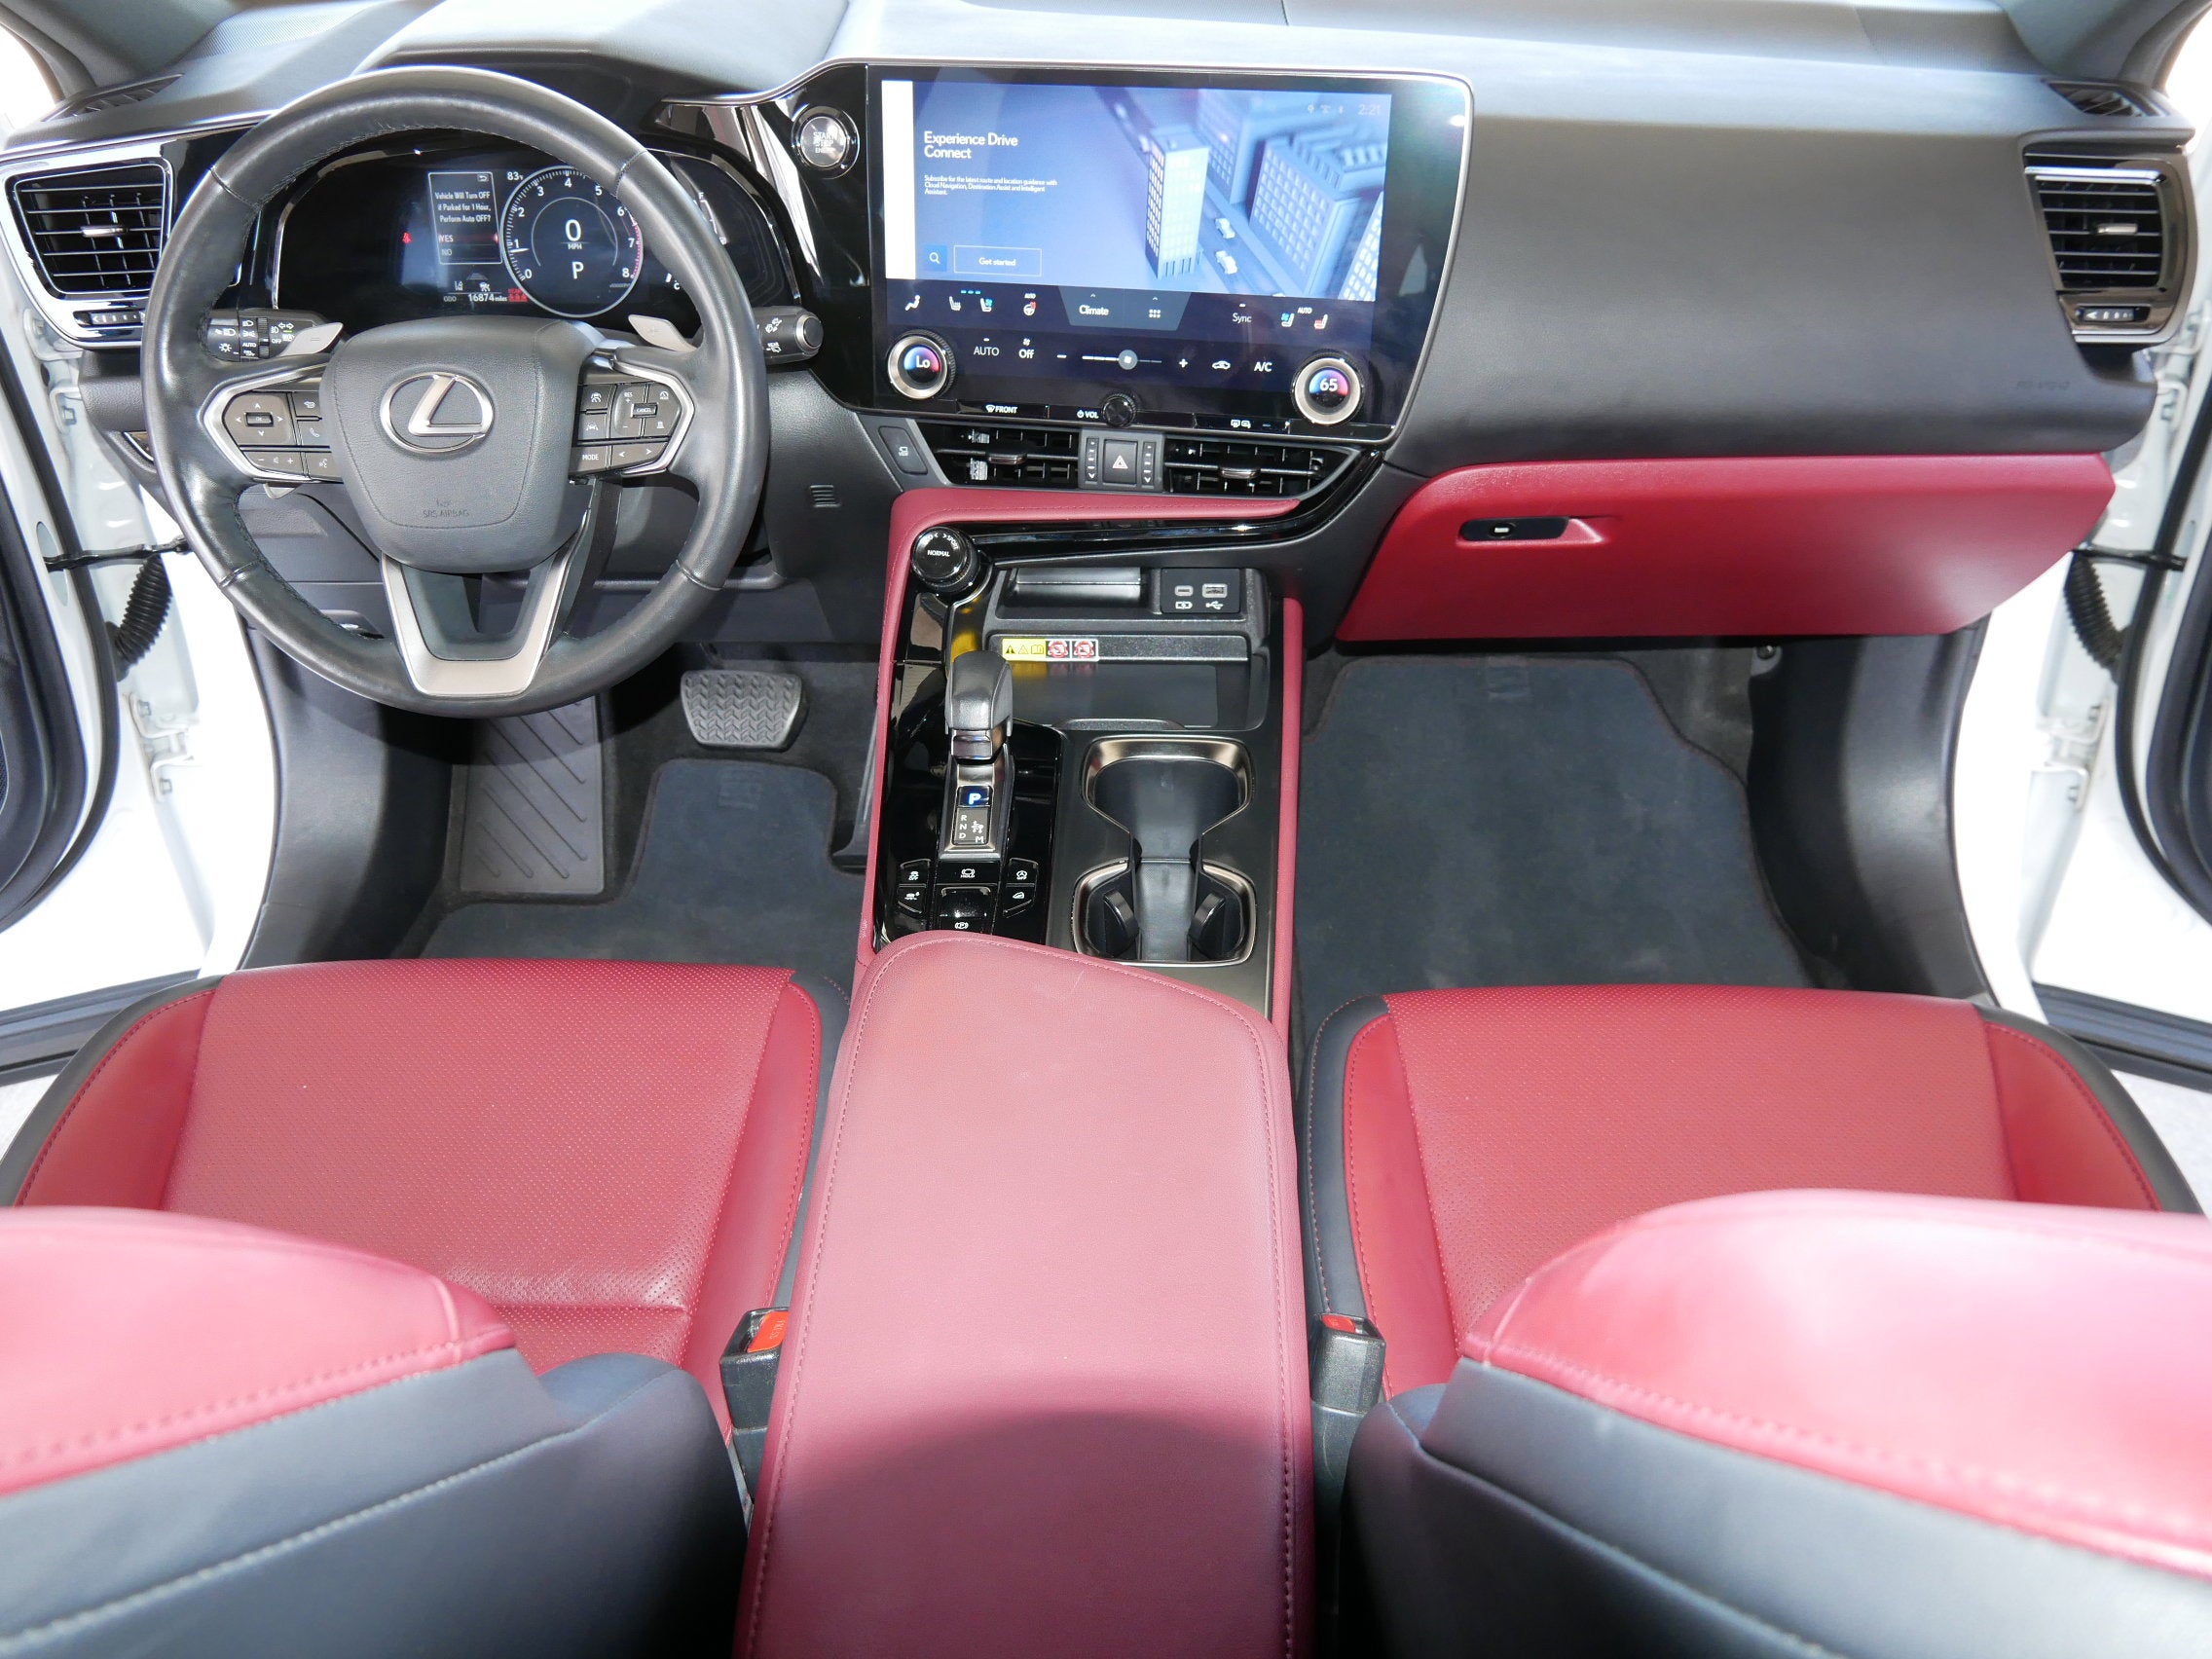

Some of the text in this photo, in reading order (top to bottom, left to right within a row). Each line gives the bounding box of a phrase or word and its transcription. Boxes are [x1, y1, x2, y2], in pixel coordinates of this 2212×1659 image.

[924, 131, 1018, 146] Experience Drive
[924, 146, 972, 160] Connect
[564, 177, 572, 188] 4
[434, 191, 491, 200] Vehicle Will Turn OFF
[537, 185, 545, 196] 3
[595, 185, 603, 196] 5
[517, 207, 526, 217] 2
[617, 206, 625, 216] 6
[565, 219, 582, 242] 0
[513, 239, 520, 248] 1
[628, 238, 635, 248] 7
[978, 257, 1016, 267] Get started
[524, 269, 533, 279] 0
[571, 261, 584, 279] P
[621, 268, 630, 278] 8
[468, 293, 495, 302] 16874
[1079, 305, 1110, 316] Climate
[1232, 313, 1253, 324] Sync
[974, 347, 1000, 357] AUTO
[1018, 349, 1035, 359] Off
[916, 355, 931, 369] Lo
[1254, 361, 1272, 373] A/C
[1319, 378, 1339, 392] 65
[994, 405, 1018, 414] FRONT
[1085, 410, 1099, 420] VOL
[927, 549, 951, 558] NORMAL
[968, 793, 982, 805] P
[975, 835, 984, 844] M
